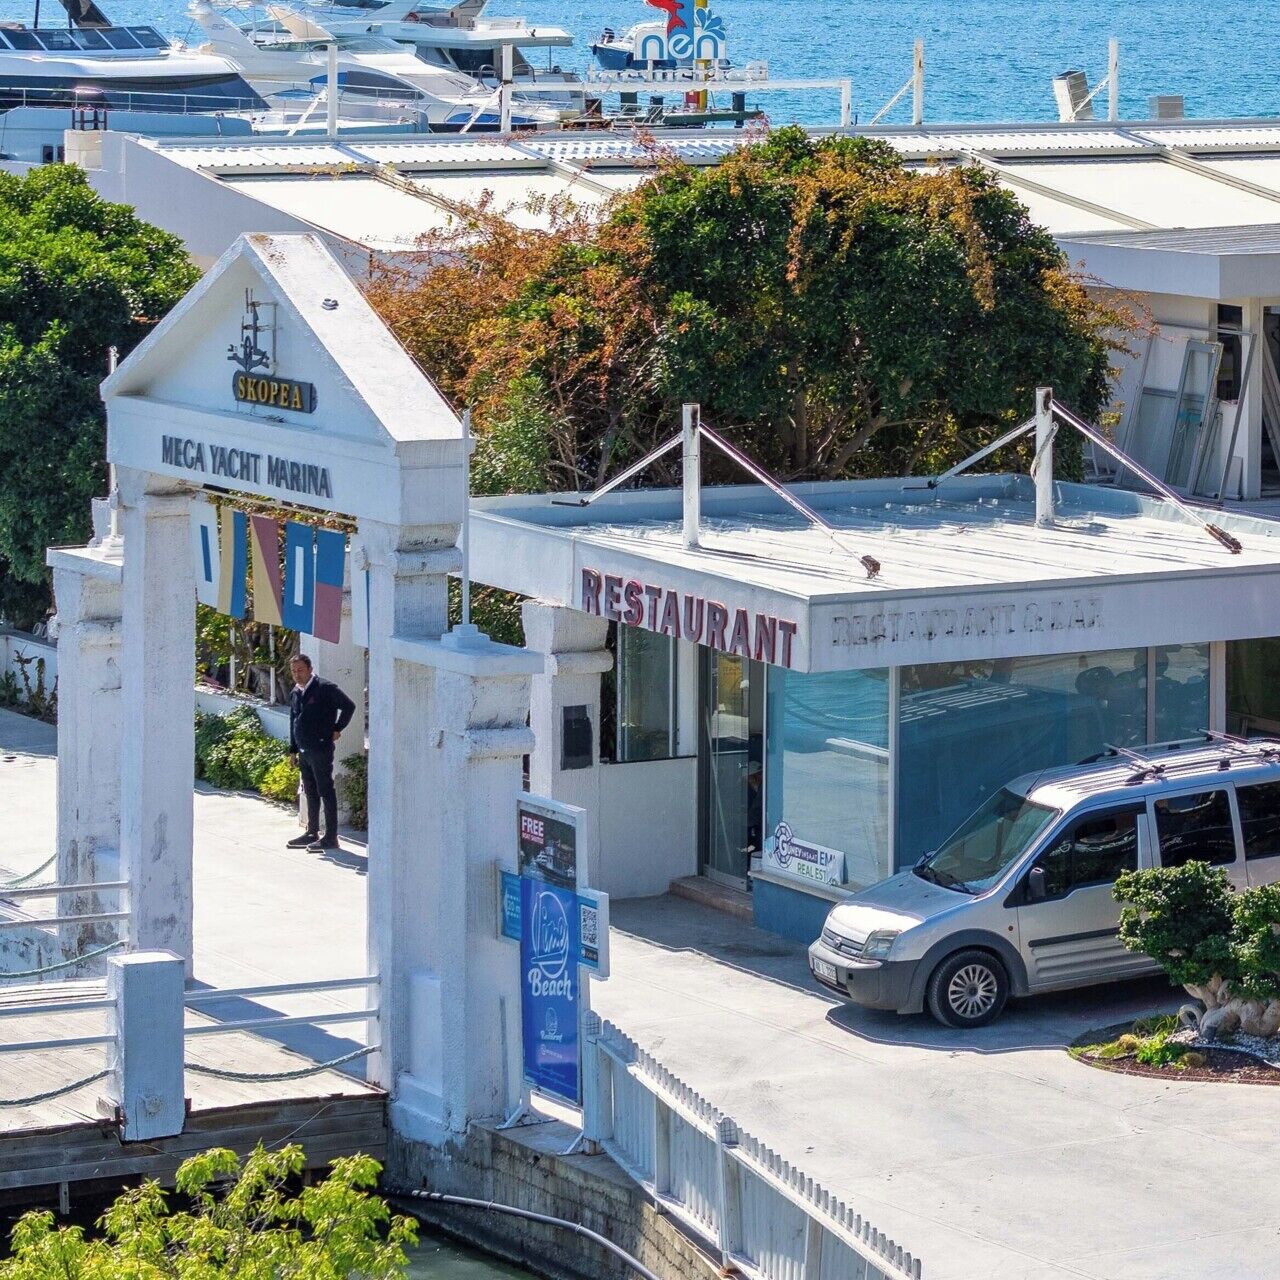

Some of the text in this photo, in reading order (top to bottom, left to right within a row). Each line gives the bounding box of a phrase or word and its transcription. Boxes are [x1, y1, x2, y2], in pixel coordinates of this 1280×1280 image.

[238, 376, 302, 408] SKOPEA
[162, 435, 333, 498] MEGA YACHT MARINA
[582, 567, 797, 669] RESTAURANT
[522, 815, 544, 837] FREE
[797, 862, 814, 879] REAL
[528, 967, 573, 1001] Beach
